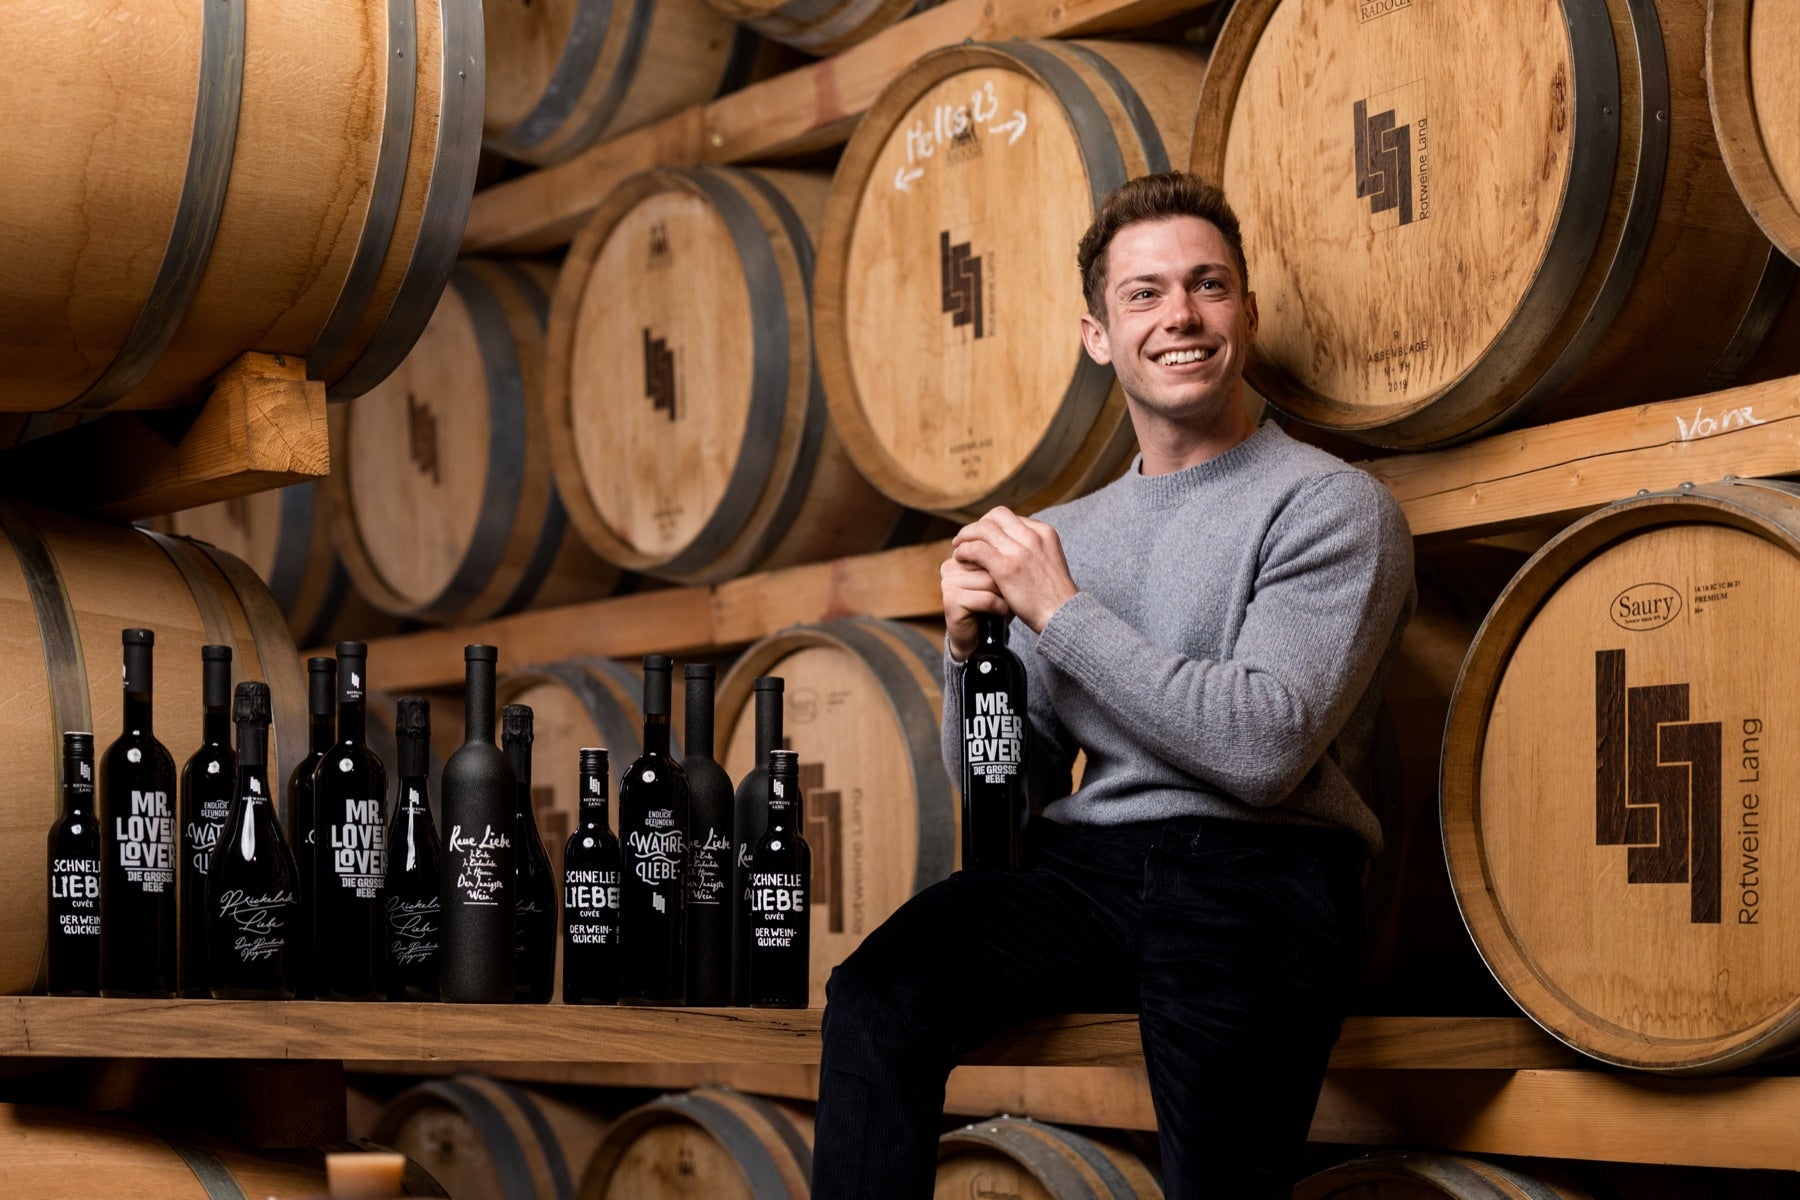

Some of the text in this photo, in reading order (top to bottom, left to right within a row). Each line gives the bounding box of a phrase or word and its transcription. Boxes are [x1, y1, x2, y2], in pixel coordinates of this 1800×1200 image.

[1361, 0, 1412, 20] RADOU
[1417, 118, 1429, 221] Rotweine Lang
[1368, 341, 1428, 363] ASSEMBLAGE
[1388, 380, 1408, 393] 2019
[1619, 596, 1674, 620] Saury
[1694, 592, 1728, 604] PREMIUM
[975, 691, 1014, 715] MR.
[965, 715, 1023, 740] LOVER
[968, 738, 1022, 763] LOVER
[973, 765, 1017, 776] DIE GROSSE
[985, 774, 1006, 784] LIEBE
[131, 790, 171, 817] MR.
[204, 799, 229, 809] ENDLICH
[345, 798, 383, 825] MR.
[648, 809, 673, 819] ENDLICH
[1738, 718, 1763, 926] Rotweine Lang
[116, 815, 176, 843] LOVER
[331, 823, 388, 850] LOVER
[449, 824, 511, 852] Raue Liebe
[703, 827, 731, 851] Liebe
[120, 841, 176, 868] LOVER
[335, 848, 388, 874] LOVER
[737, 843, 753, 868] Rau
[53, 859, 101, 873] SCHNEL
[52, 875, 101, 898] LIEB
[127, 871, 173, 883] DIE GROSSE
[341, 877, 385, 889] DIE GROSSE
[457, 873, 474, 888] Der
[566, 871, 616, 884] SCHNELLE
[753, 873, 802, 886] SCHNELLE
[72, 899, 94, 908] CUVÉE
[565, 886, 619, 909] LIEBE
[751, 889, 804, 912] LIEBE
[60, 915, 101, 925] DER WEIN
[233, 907, 285, 935] Liebe
[579, 909, 600, 918] CUVÉE
[764, 911, 785, 920] CUVÉE
[64, 925, 101, 935] QUICKIE
[391, 912, 438, 939] Liebe
[569, 925, 612, 934] DER WEIN-
[755, 928, 797, 938] DER WEIN-
[572, 934, 606, 944] QUICKIE
[758, 938, 791, 947] QUICKIE
